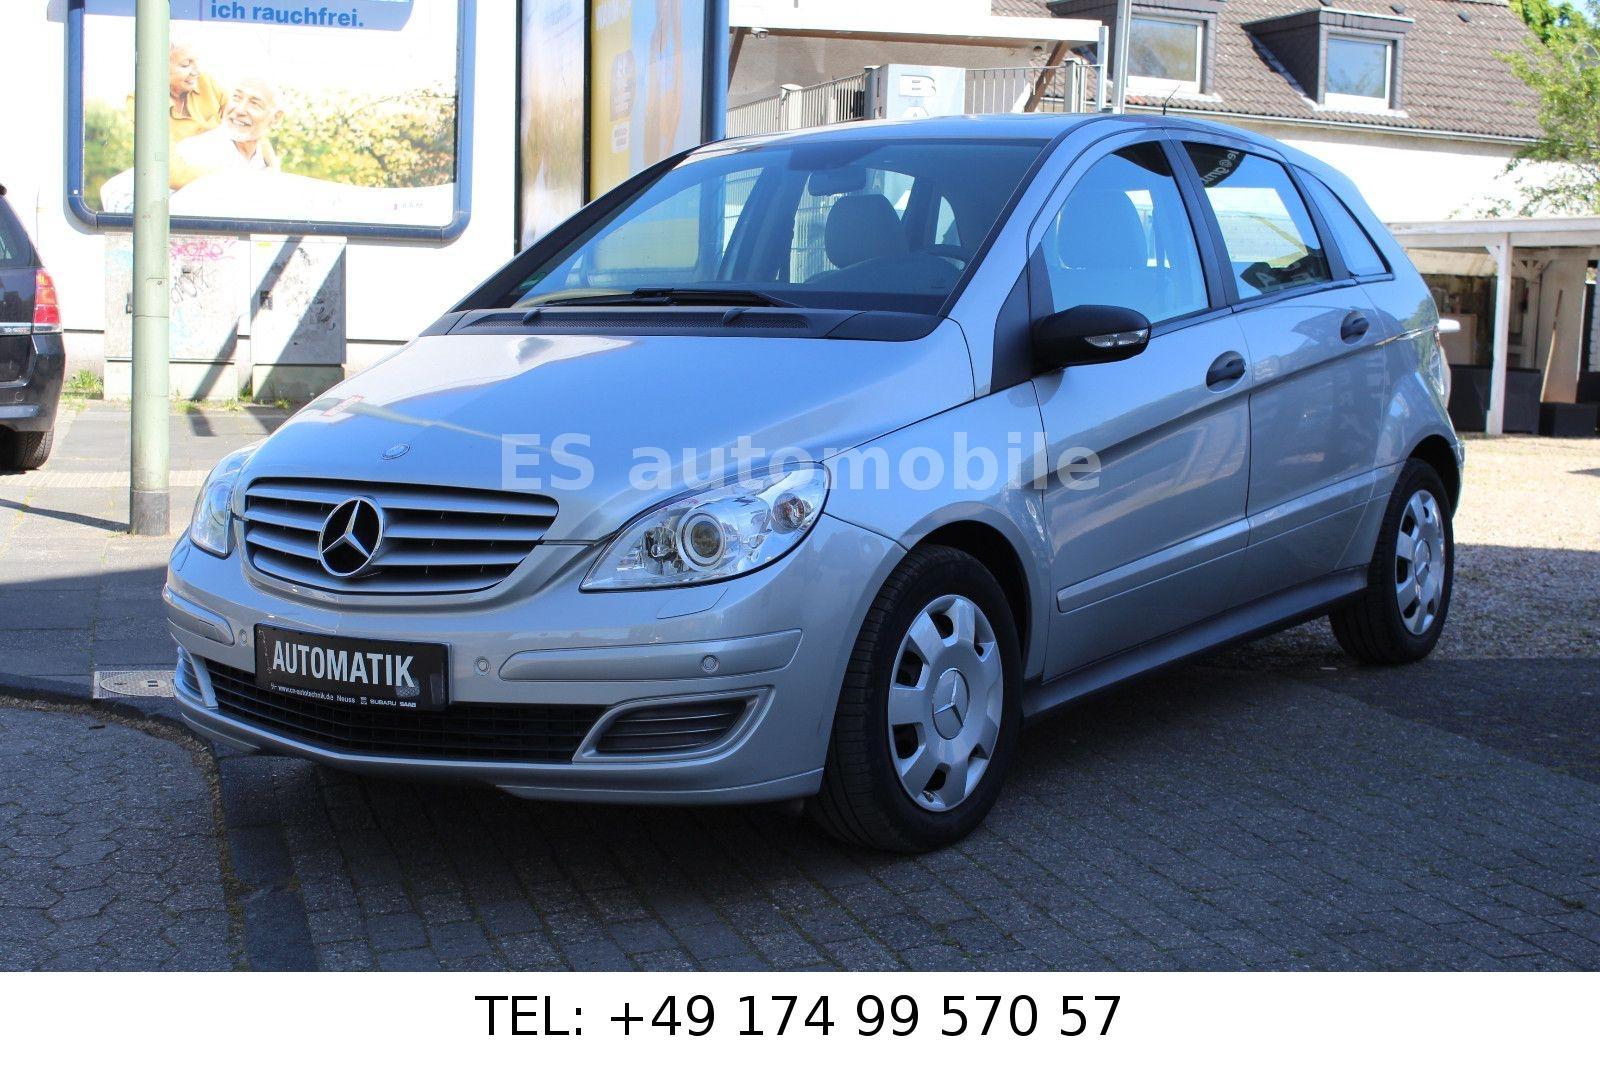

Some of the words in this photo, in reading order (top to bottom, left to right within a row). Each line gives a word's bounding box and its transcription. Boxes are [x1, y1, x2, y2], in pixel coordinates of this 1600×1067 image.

[211, 0, 246, 19] ich
[252, 6, 364, 28] rauchfrei.
[272, 640, 415, 687] AUTOMATIK
[336, 694, 356, 704] Neuss
[369, 698, 397, 706] SUBARU
